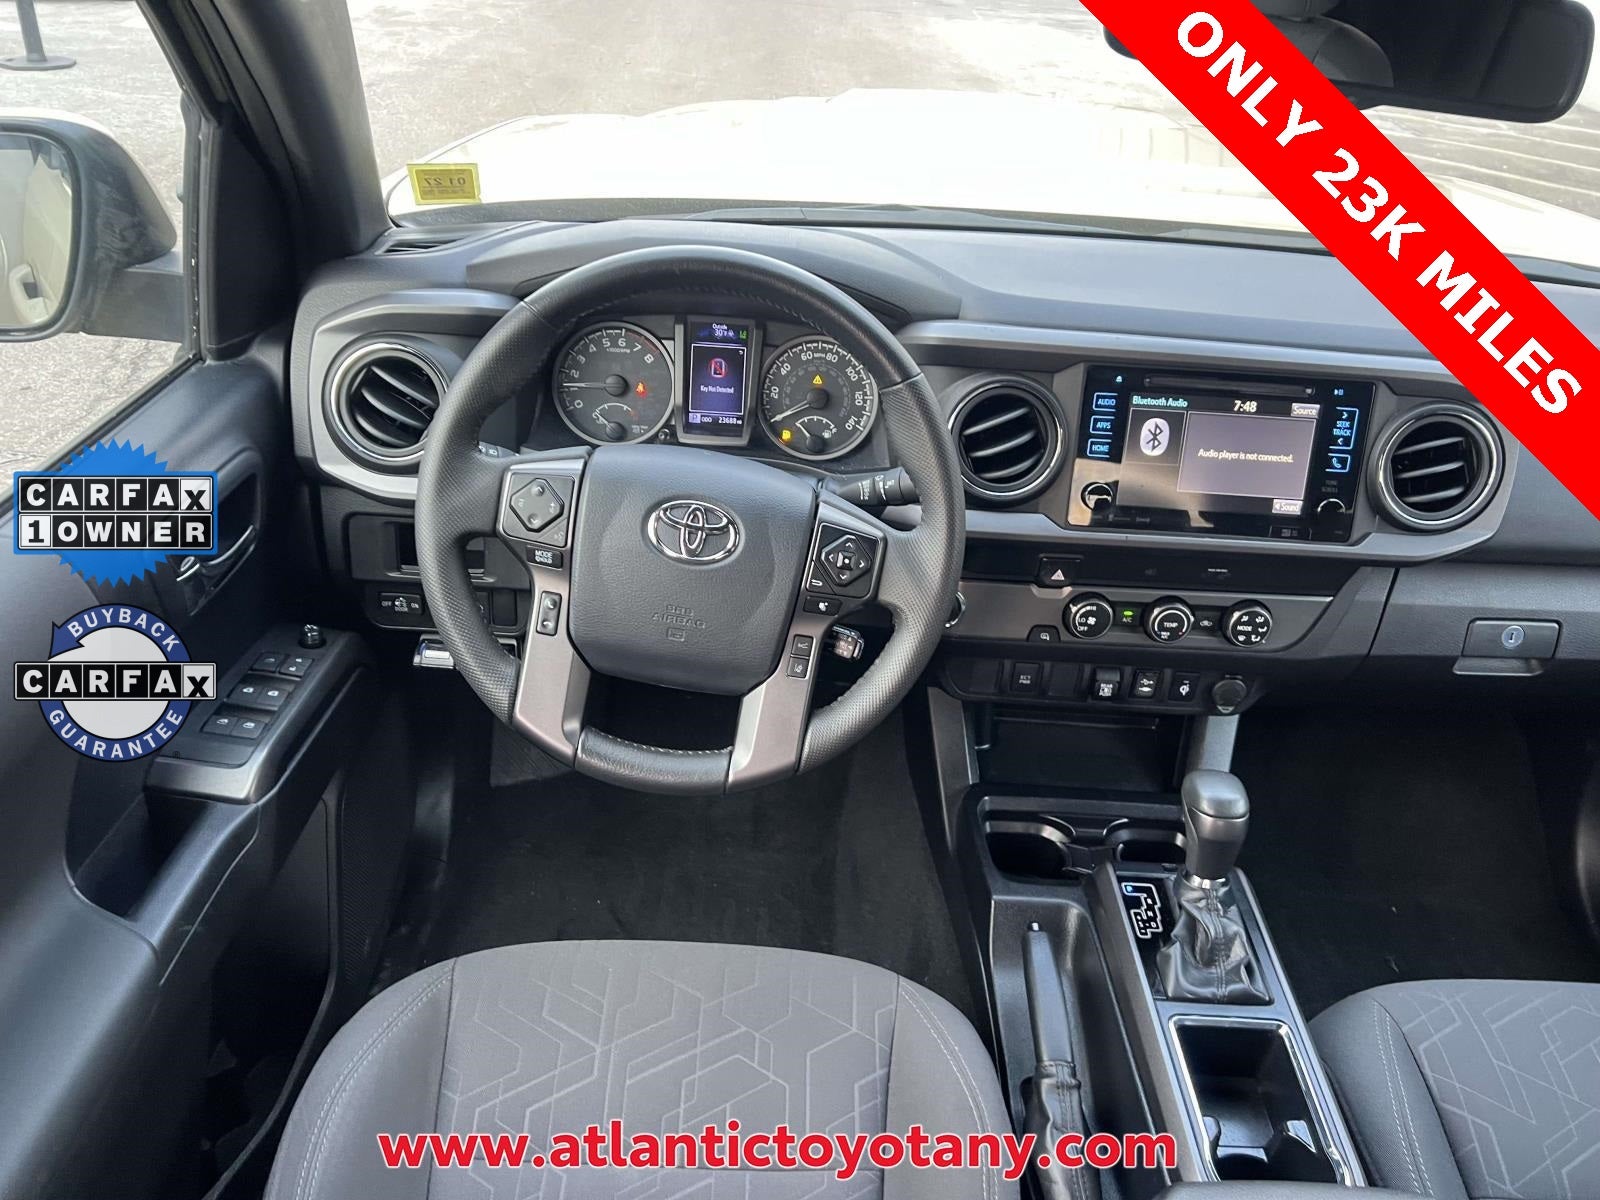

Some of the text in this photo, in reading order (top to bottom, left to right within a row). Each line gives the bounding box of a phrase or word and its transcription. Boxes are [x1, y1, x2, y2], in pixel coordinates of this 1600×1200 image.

[602, 338, 611, 347] 5
[618, 338, 626, 347] 6
[633, 342, 642, 353] 7
[589, 343, 597, 353] 4
[577, 355, 586, 364] 3
[644, 353, 654, 364] 8
[801, 351, 813, 361] 60
[826, 352, 839, 362] 80
[570, 370, 580, 378] 2
[780, 363, 791, 376] 40
[845, 366, 859, 381] 100
[771, 386, 779, 399] 20
[855, 391, 863, 406] 120
[1132, 395, 1189, 407] Bluetooth Audio
[574, 400, 583, 409] 0
[1233, 400, 1257, 412] 7:48
[1292, 406, 1317, 416] Source
[845, 415, 859, 431] 140
[1333, 428, 1351, 436] TRACK
[1092, 444, 1109, 452] HOME
[1198, 448, 1294, 463] Audio player is not connected.
[1281, 503, 1299, 512] Sound
